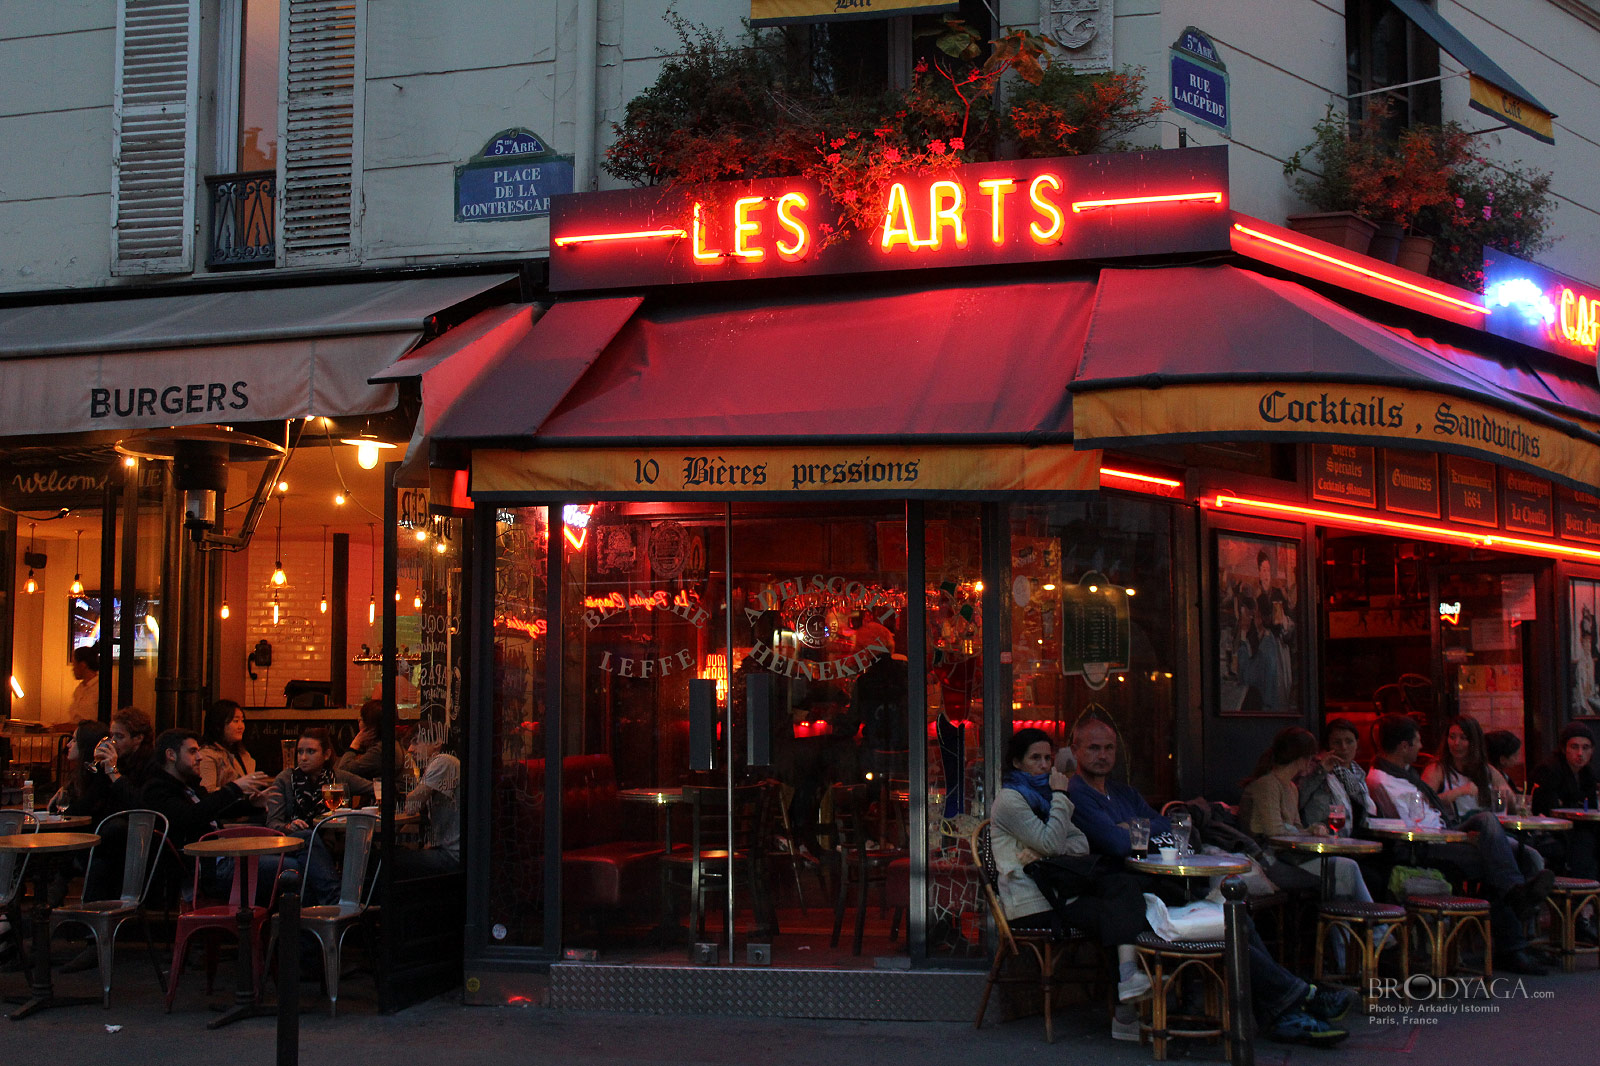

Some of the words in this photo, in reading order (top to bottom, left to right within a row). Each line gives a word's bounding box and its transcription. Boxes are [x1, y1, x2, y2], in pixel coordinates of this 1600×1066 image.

[1190, 73, 1211, 94] RUE
[1174, 86, 1226, 119] LACÉPÈDE
[493, 167, 541, 184] PLACE
[495, 185, 514, 199] DE
[519, 183, 538, 198] LA
[692, 191, 811, 266] LES
[880, 174, 1065, 253] ARTS
[91, 381, 249, 419] BURGERS
[1259, 390, 1405, 429] Cocktails
[1433, 402, 1541, 459] Sandwiches
[633, 458, 660, 485] 10
[682, 457, 768, 490] Bières
[792, 456, 921, 490] pressions
[1318, 477, 1346, 494] Cocktails
[1463, 490, 1482, 510] 1664
[581, 589, 710, 632] BLANCHE
[743, 574, 900, 628] ADELSCOTT
[598, 648, 696, 679] LEFFE
[747, 636, 891, 682] HEINEKEN
